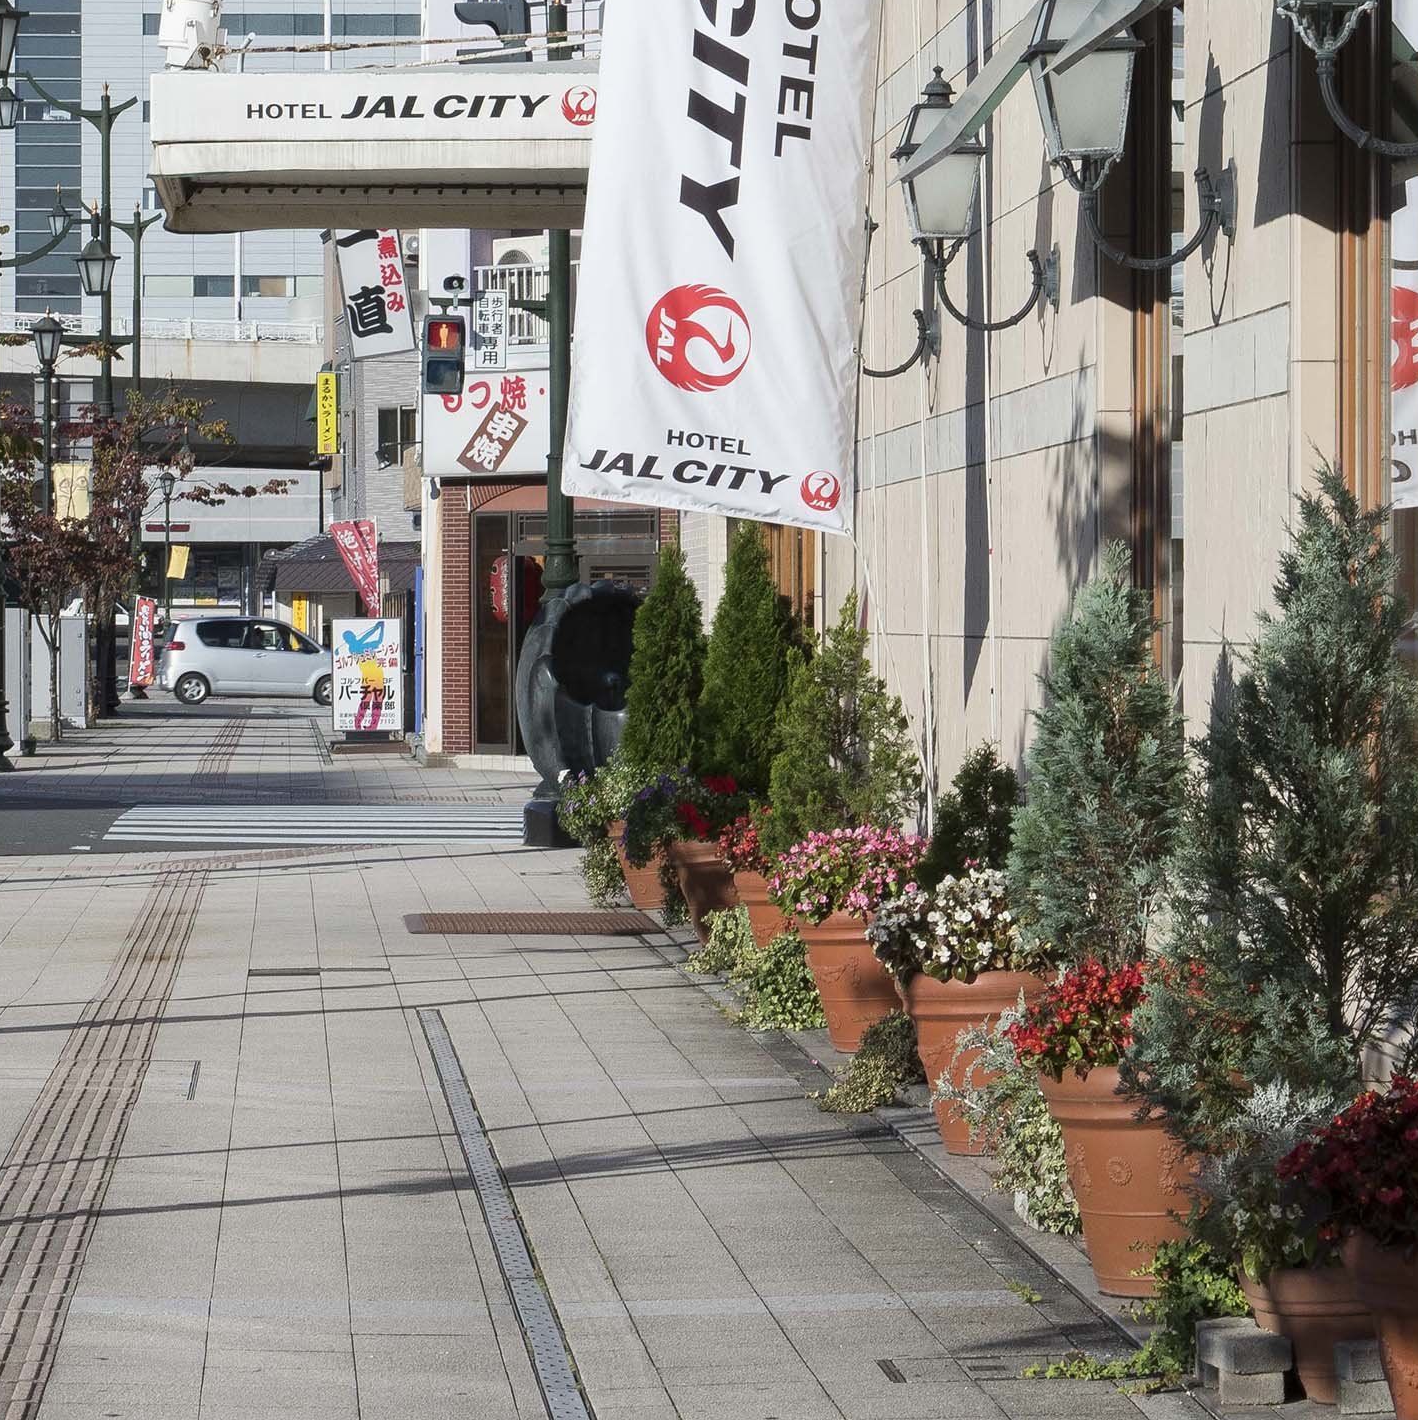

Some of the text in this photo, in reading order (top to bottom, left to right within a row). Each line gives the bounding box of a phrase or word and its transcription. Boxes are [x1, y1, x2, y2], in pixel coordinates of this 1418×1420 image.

[246, 103, 332, 119] HOTEL
[377, 228, 405, 312] 煮込み
[478, 297, 490, 335] 自転車
[491, 296, 504, 335] 歩行者
[482, 336, 498, 365] 専用
[657, 307, 677, 365] JAL
[322, 378, 333, 442] まるかいラーメン
[465, 411, 519, 471] 串焼
[667, 429, 751, 456] HOTEL
[810, 499, 834, 510] JAL
[339, 685, 395, 701] バーチャル
[340, 677, 376, 685] ゴルフバー
